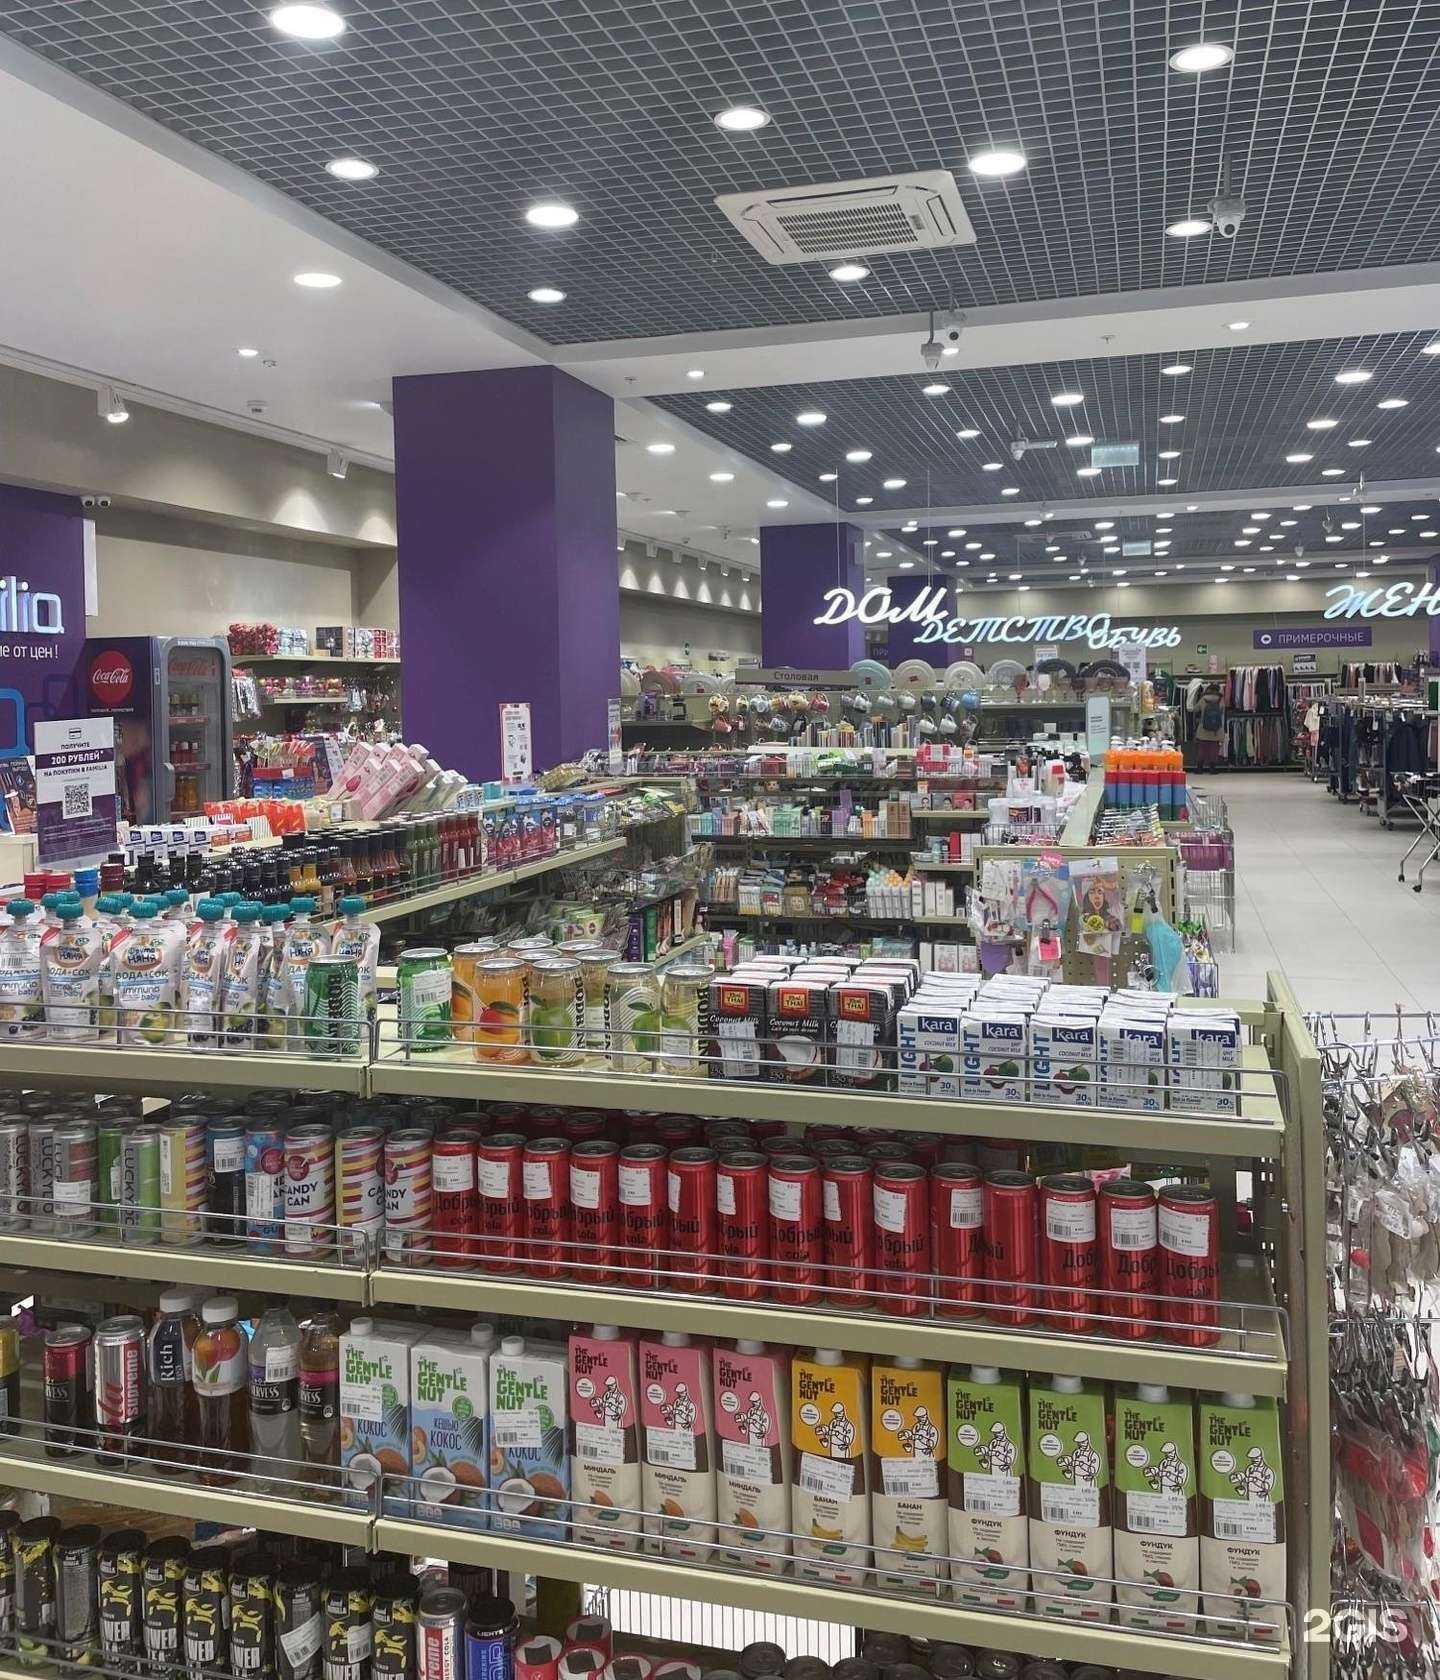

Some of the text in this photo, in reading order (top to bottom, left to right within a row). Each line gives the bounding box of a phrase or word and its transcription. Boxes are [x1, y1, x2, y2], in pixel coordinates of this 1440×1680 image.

[813, 586, 949, 626] ДОМ
[1278, 632, 1365, 645] ПРИМЕРОЧНЫЕ
[14, 648, 26, 658] от
[773, 671, 819, 681] Столовая
[51, 756, 67, 765] 200
[922, 1018, 953, 1032] kara
[987, 1023, 1019, 1038] kara
[1057, 1028, 1089, 1042] kara
[1125, 1030, 1158, 1045] kara
[1196, 1030, 1231, 1044] kara
[900, 1023, 917, 1079] LIGHT
[963, 1030, 981, 1086] LIGHT
[1033, 1033, 1050, 1090] LIGHT
[287, 1195, 310, 1206] CAN
[346, 1347, 364, 1360] THE
[575, 1346, 588, 1356] THE
[645, 1351, 658, 1362] THE
[160, 1344, 174, 1382] Rich
[418, 1359, 438, 1372] THE
[575, 1353, 608, 1367] GENTLE
[645, 1358, 678, 1374] GENTLE
[719, 1359, 732, 1368] THE
[346, 1357, 392, 1379] GENTLE
[497, 1367, 517, 1380] THE
[575, 1365, 592, 1375] NUT
[719, 1366, 752, 1382] GENTLE
[418, 1368, 467, 1391] GENTLE
[645, 1369, 663, 1381] NUT
[799, 1370, 813, 1380] THE
[880, 1376, 895, 1386] THE
[126, 1348, 138, 1419] supreme
[497, 1377, 547, 1400] GENTLE
[719, 1378, 737, 1388] NUT
[799, 1378, 835, 1393] GENTLE
[418, 1386, 445, 1402] NUT
[799, 1390, 819, 1400] NUT
[880, 1383, 918, 1398] GENTLE
[956, 1389, 971, 1400] THE
[880, 1395, 900, 1406] NUT
[956, 1397, 994, 1413] GENTLE
[1038, 1399, 1054, 1410] THE
[956, 1410, 977, 1421] NUT
[1038, 1407, 1077, 1422] GENTLE
[1124, 1409, 1140, 1421] THE
[1209, 1415, 1225, 1425] THE
[1038, 1420, 1059, 1430] NUT
[1124, 1416, 1165, 1432] GENTLE
[1210, 1421, 1251, 1437] GENTLE
[430, 1430, 462, 1450] КОКОС
[1125, 1430, 1146, 1441] NUT
[1210, 1435, 1232, 1446] NUT
[583, 1464, 617, 1475] МИНДАЛЬ
[654, 1471, 687, 1483] МИНДАЛЬ
[728, 1481, 761, 1493] МИНДАЛЬ
[813, 1495, 838, 1505] БАНАН
[897, 1502, 922, 1511] БАНАН
[971, 1518, 1002, 1528] ФУНДУК
[1054, 1529, 1087, 1539] ФУНДУК
[1140, 1540, 1174, 1550] ФУНДУК
[1227, 1546, 1261, 1556] ФУНДУК
